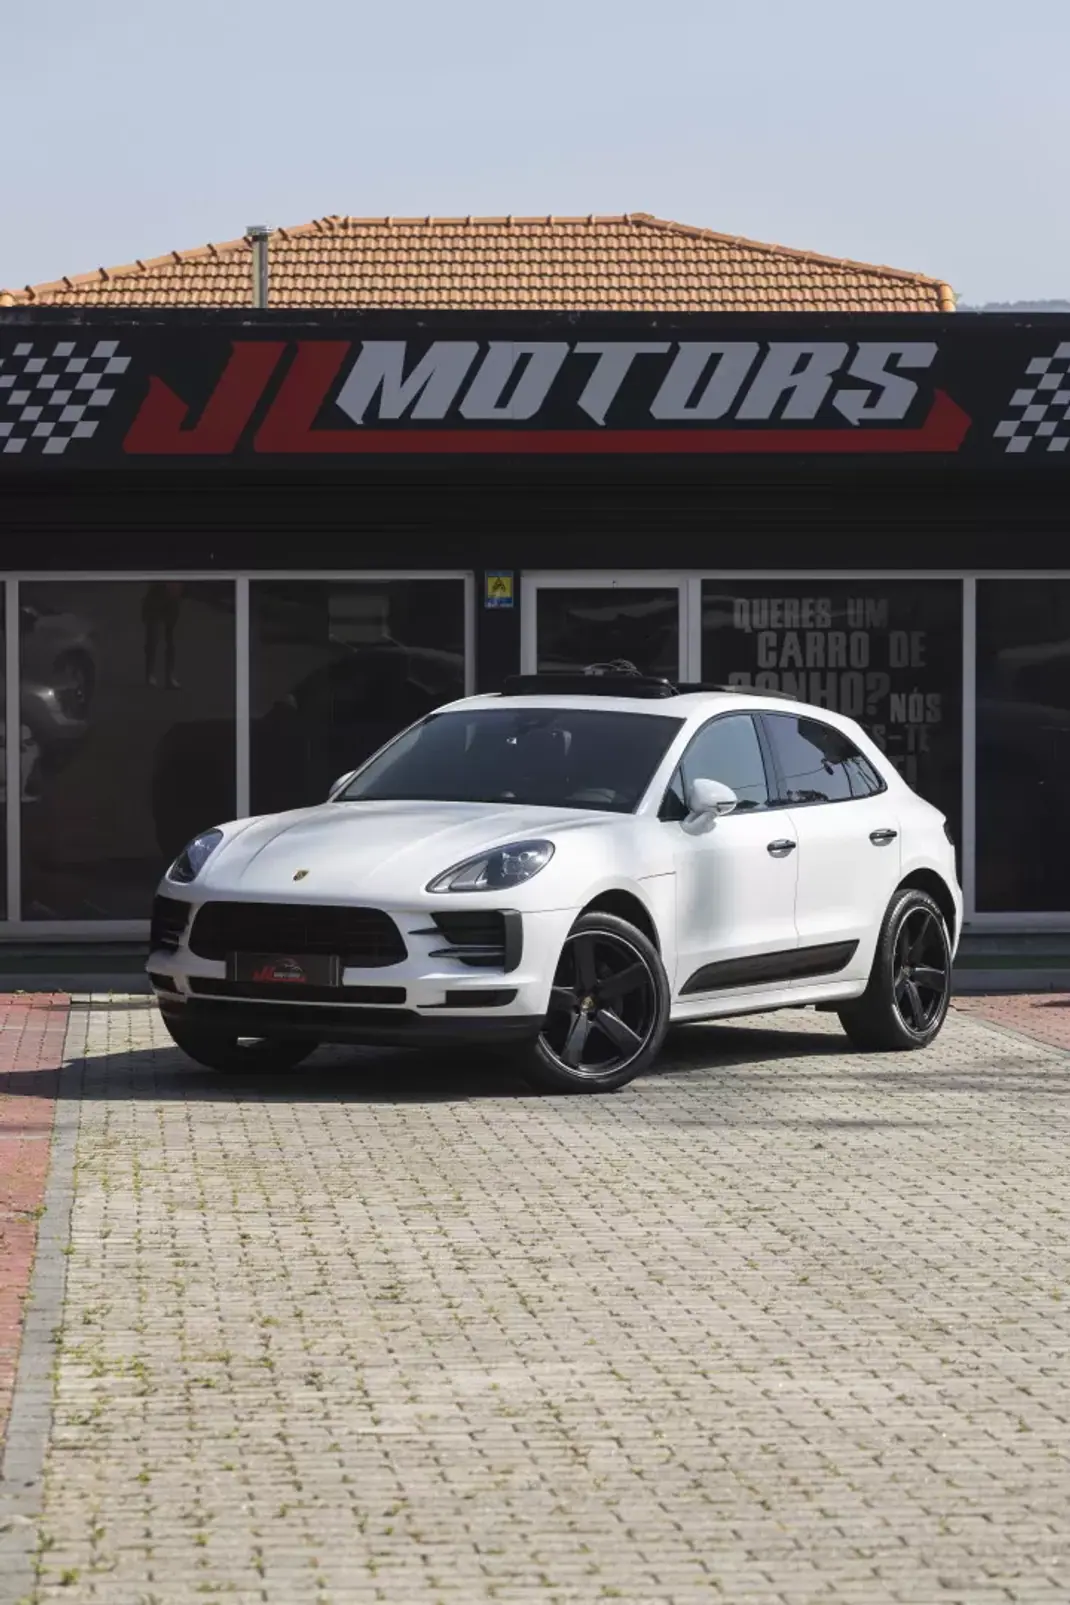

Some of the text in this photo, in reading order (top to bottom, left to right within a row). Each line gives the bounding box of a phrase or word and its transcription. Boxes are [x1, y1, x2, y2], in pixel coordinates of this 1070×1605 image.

[335, 340, 939, 426] MOTORS
[733, 598, 889, 632] QUERES UM
[757, 631, 927, 668] CARRO DE
[890, 687, 942, 723] NÓS
